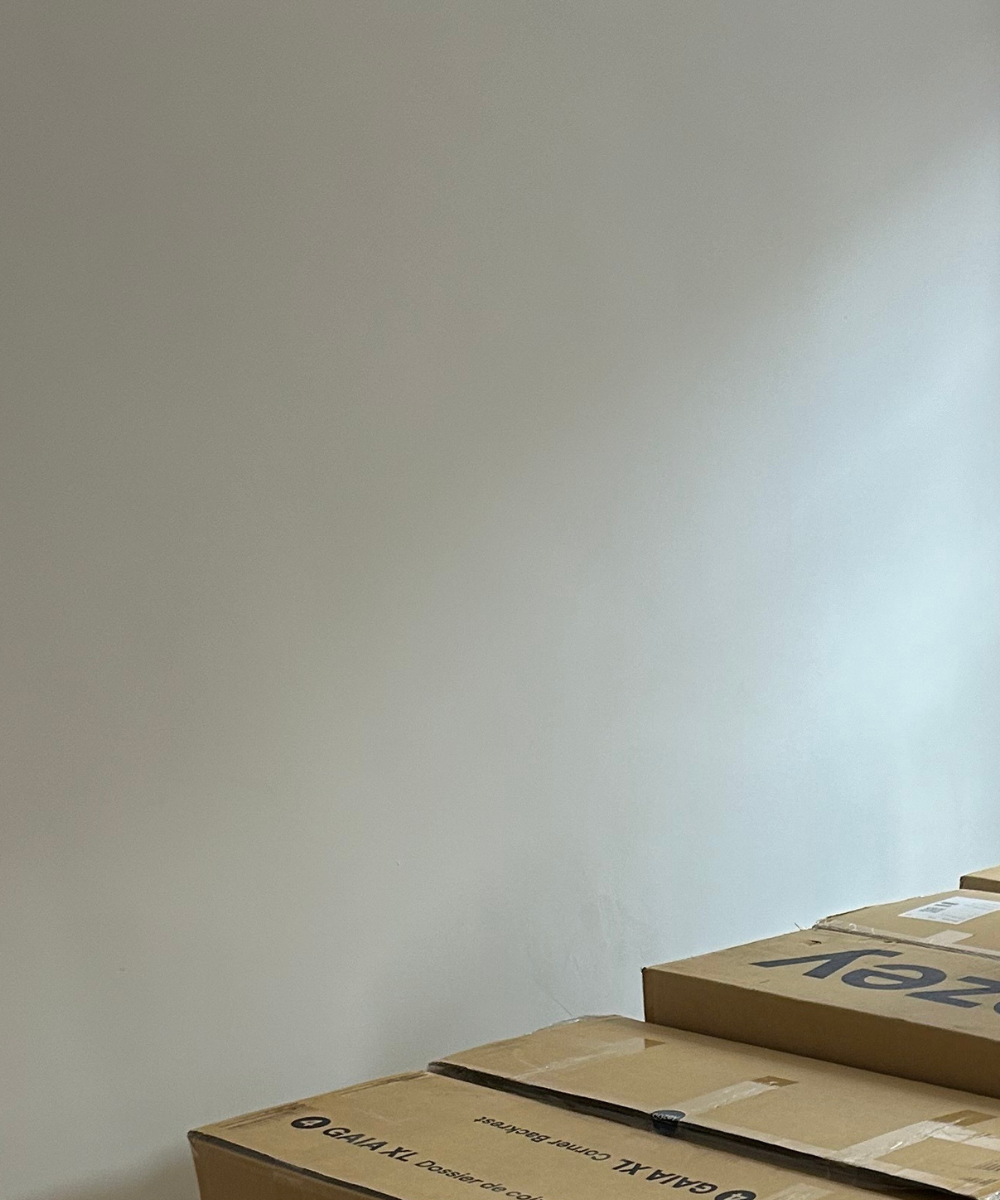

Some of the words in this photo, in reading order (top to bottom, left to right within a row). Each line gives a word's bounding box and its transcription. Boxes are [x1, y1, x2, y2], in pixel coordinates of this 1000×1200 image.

[474, 1116, 551, 1143] Backrest
[322, 1127, 388, 1151] GAIA
[378, 1146, 418, 1162] XL
[414, 1160, 484, 1184] Dossier
[480, 1182, 507, 1193] de
[549, 1140, 612, 1161] Corner
[612, 1158, 653, 1176] XL
[646, 1169, 718, 1194] GAIA
